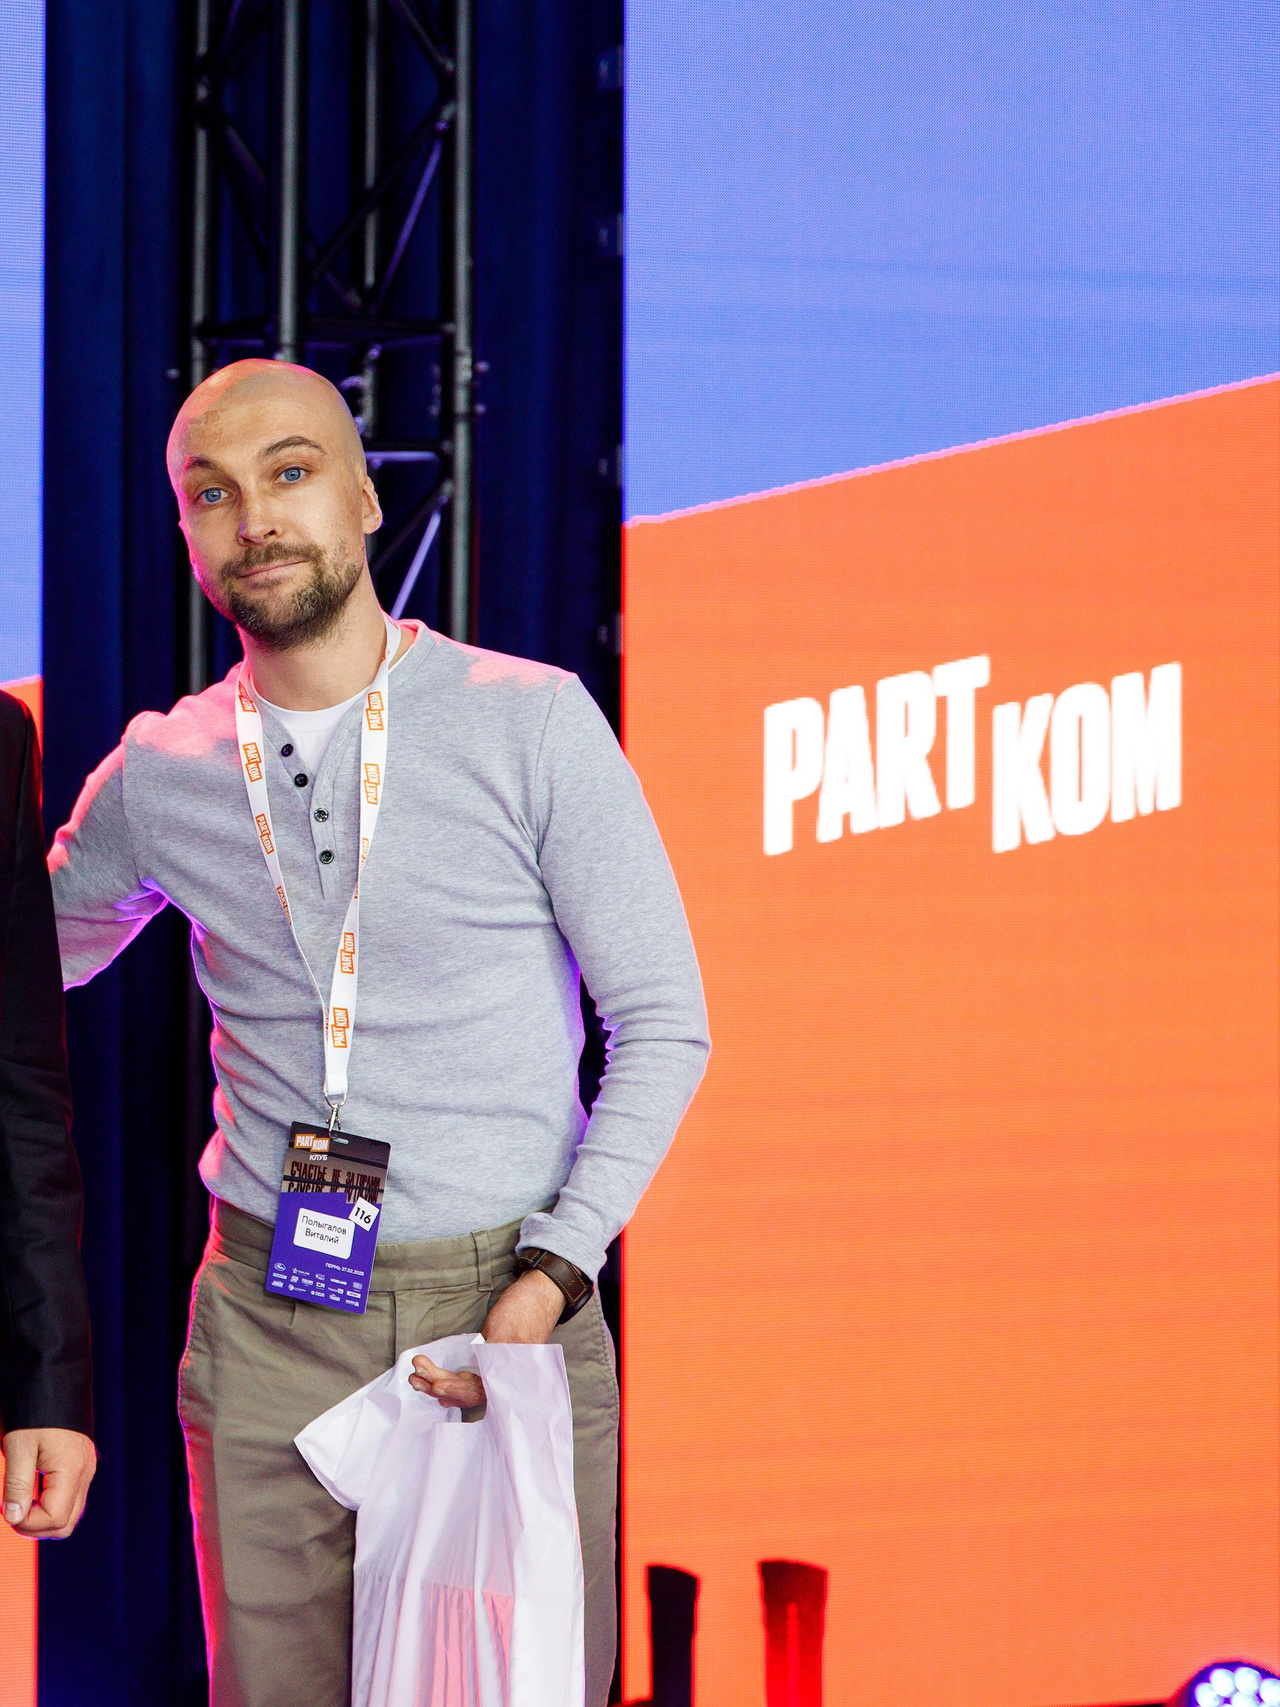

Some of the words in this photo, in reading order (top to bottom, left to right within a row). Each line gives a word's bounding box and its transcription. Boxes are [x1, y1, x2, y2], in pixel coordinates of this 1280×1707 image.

[369, 692, 383, 711] KOM
[367, 709, 383, 730] PART
[245, 744, 261, 764] PART
[763, 653, 991, 856] PART
[991, 661, 1183, 853] KOM
[247, 761, 261, 781] KOM
[366, 764, 380, 785] KOM
[366, 783, 379, 804] PART
[257, 815, 270, 836] PART
[261, 833, 274, 853] KOM
[345, 933, 355, 953] KOM
[341, 951, 355, 973] PART
[334, 1008, 348, 1027] KOM
[333, 1026, 346, 1047] PART
[295, 1135, 315, 1147] PART
[312, 1139, 329, 1151] KOM
[290, 1160, 328, 1181] СЧАСТЬЕ
[332, 1168, 342, 1184] НЕ
[345, 1171, 355, 1186] ЗА
[301, 1215, 347, 1235] Полыгалов
[354, 1206, 372, 1224] 116
[304, 1227, 340, 1245] Виталий
